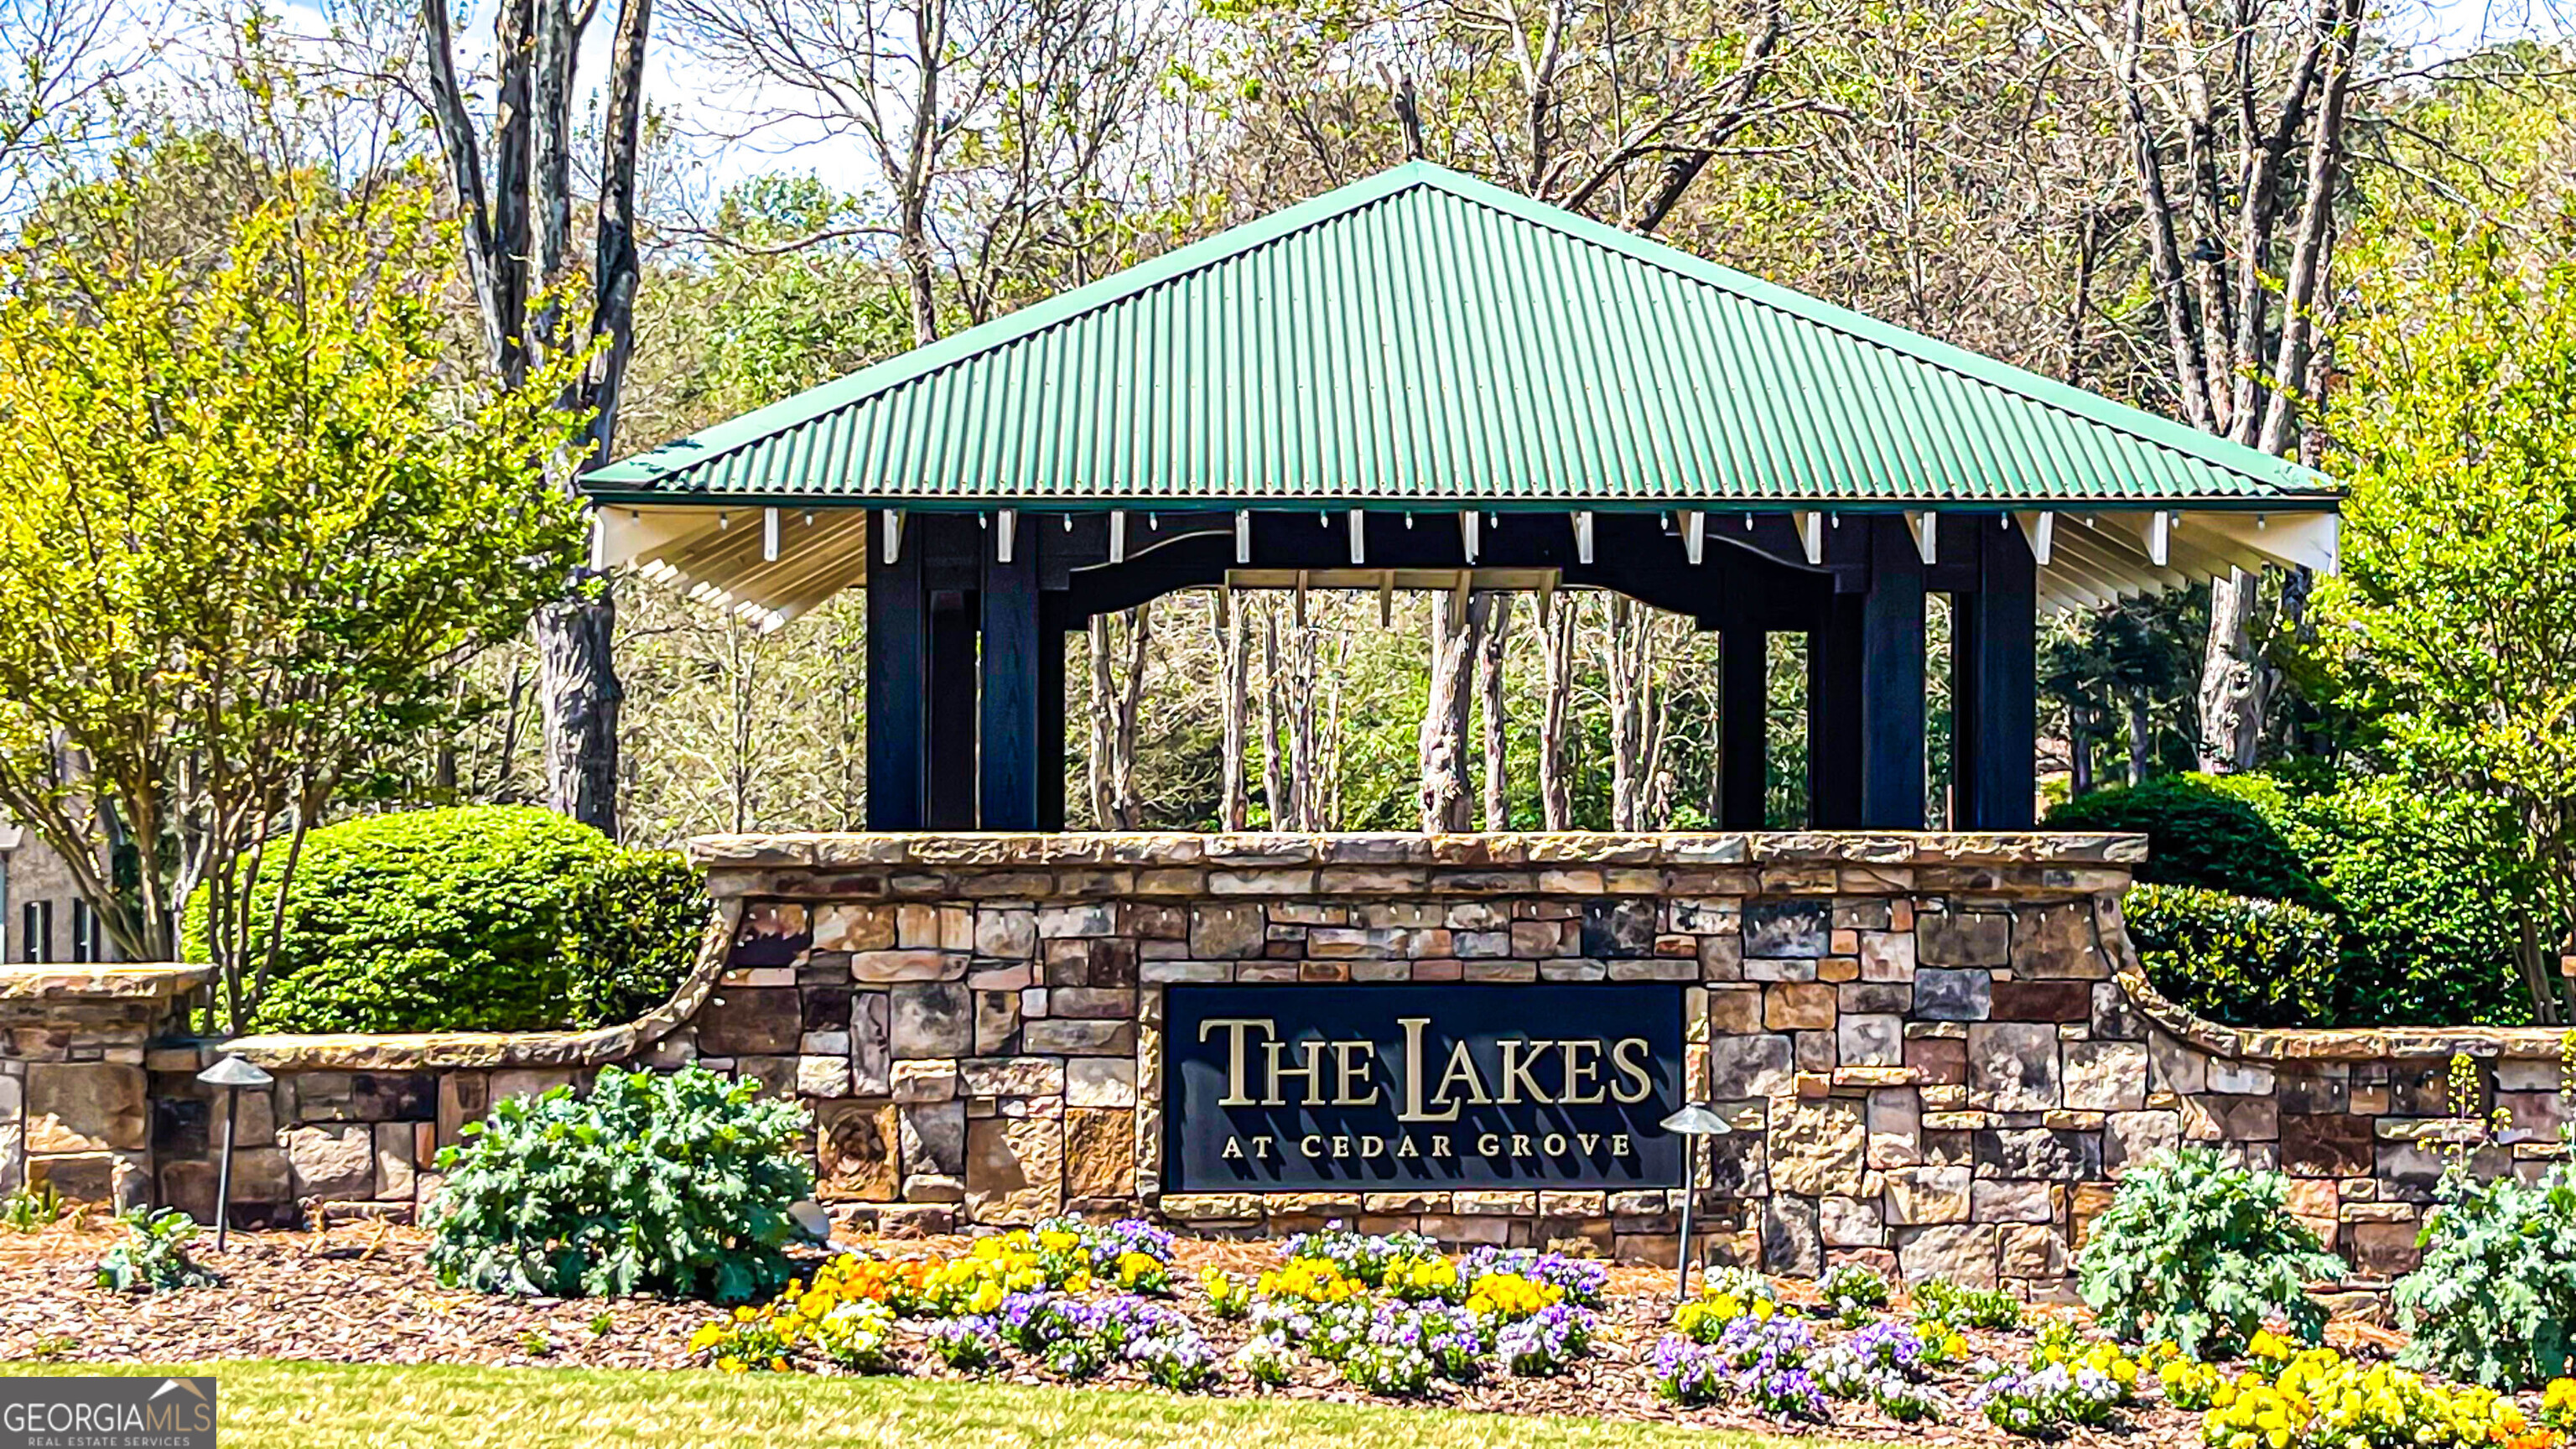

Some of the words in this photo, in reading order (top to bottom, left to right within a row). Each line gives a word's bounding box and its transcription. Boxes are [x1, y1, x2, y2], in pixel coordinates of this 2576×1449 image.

[1199, 1017, 1379, 1107] THE
[1396, 1017, 1654, 1123] LAKES
[1221, 1135, 1273, 1159] AT
[1300, 1134, 1453, 1159] CEDAR
[1477, 1133, 1631, 1158] GROVE
